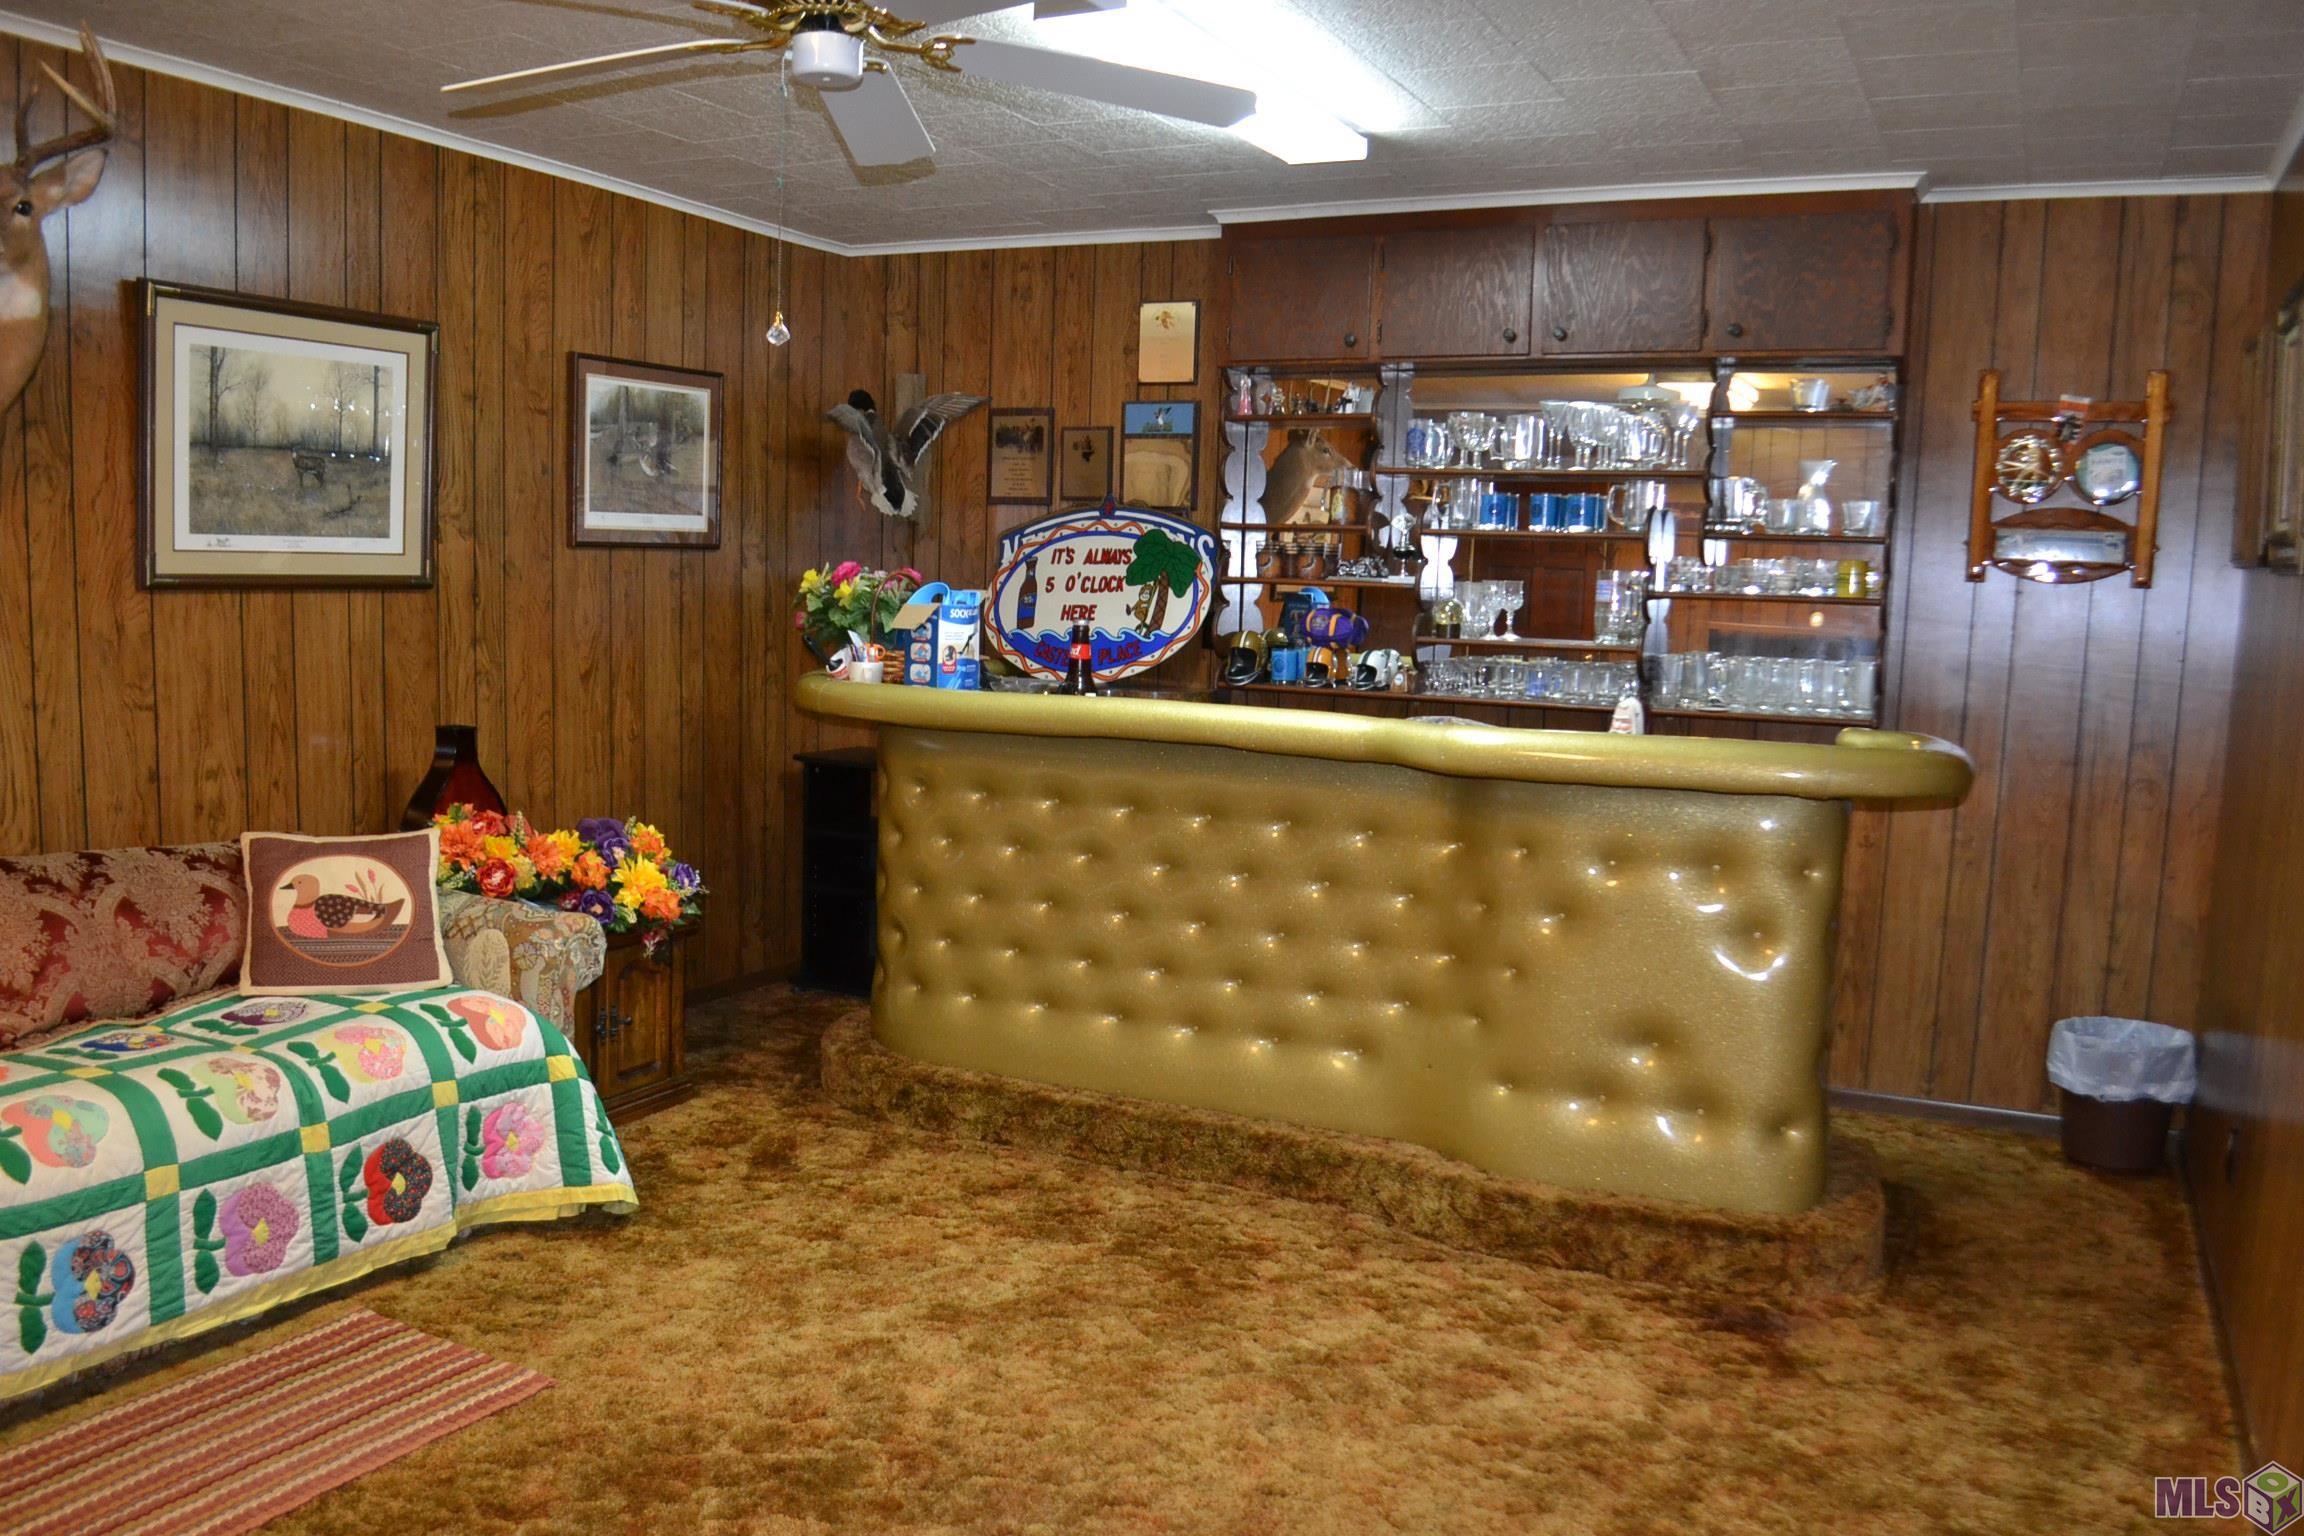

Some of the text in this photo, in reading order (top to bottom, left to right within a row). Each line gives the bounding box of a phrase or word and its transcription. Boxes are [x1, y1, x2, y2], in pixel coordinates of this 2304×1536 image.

[1051, 546, 1075, 565] IT'S
[1083, 548, 1133, 565] ALWAYS
[1045, 571, 1126, 594] 5 O'CLOCK
[1060, 604, 1097, 621] HERE
